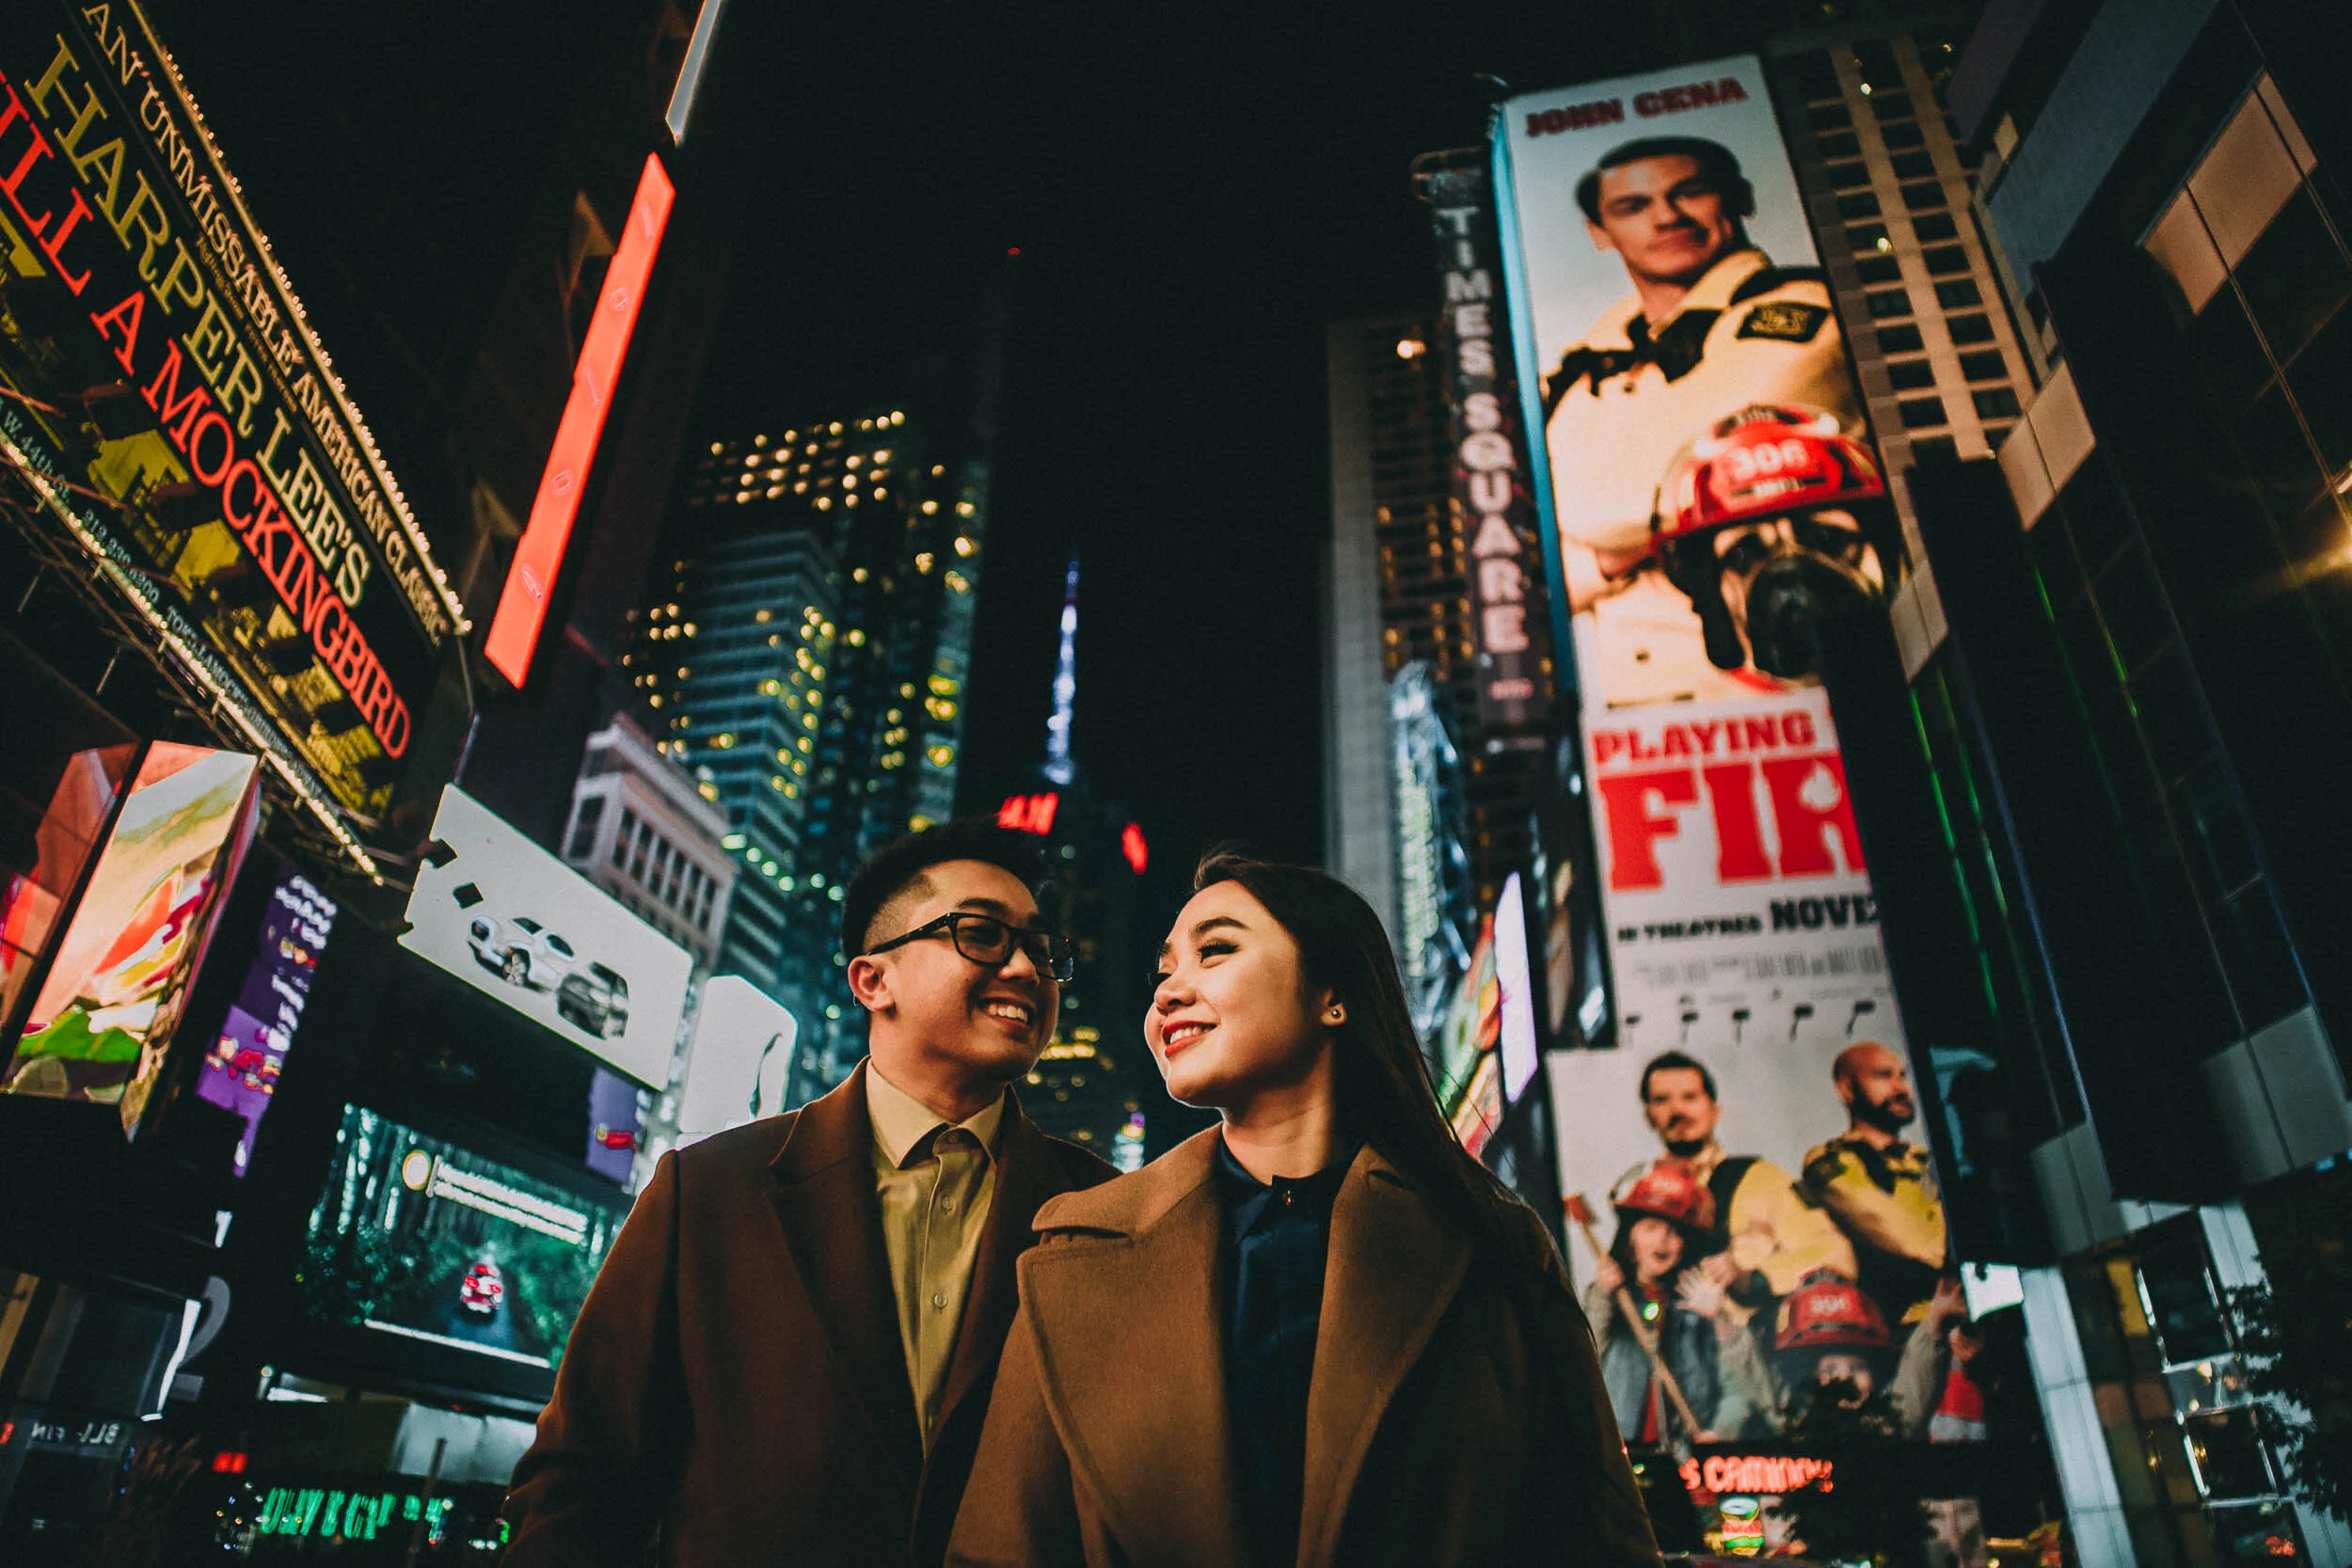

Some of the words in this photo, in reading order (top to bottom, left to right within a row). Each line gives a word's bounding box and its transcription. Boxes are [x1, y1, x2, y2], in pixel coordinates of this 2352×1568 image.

[1526, 98, 1624, 136] JOHN
[1633, 77, 1749, 119] CENA
[0, 70, 92, 295] ILL
[90, 290, 146, 376] A
[140, 338, 412, 760] MOCKINGBIRD
[24, 33, 265, 439] HARPER
[257, 408, 371, 608] LEE'S
[138, 79, 306, 378] UNMISSABLE
[292, 371, 389, 545] AMERICAN
[1435, 205, 1496, 378] TIMES
[1460, 392, 1530, 653] SQUARE
[1594, 710, 1815, 765] PLAYING
